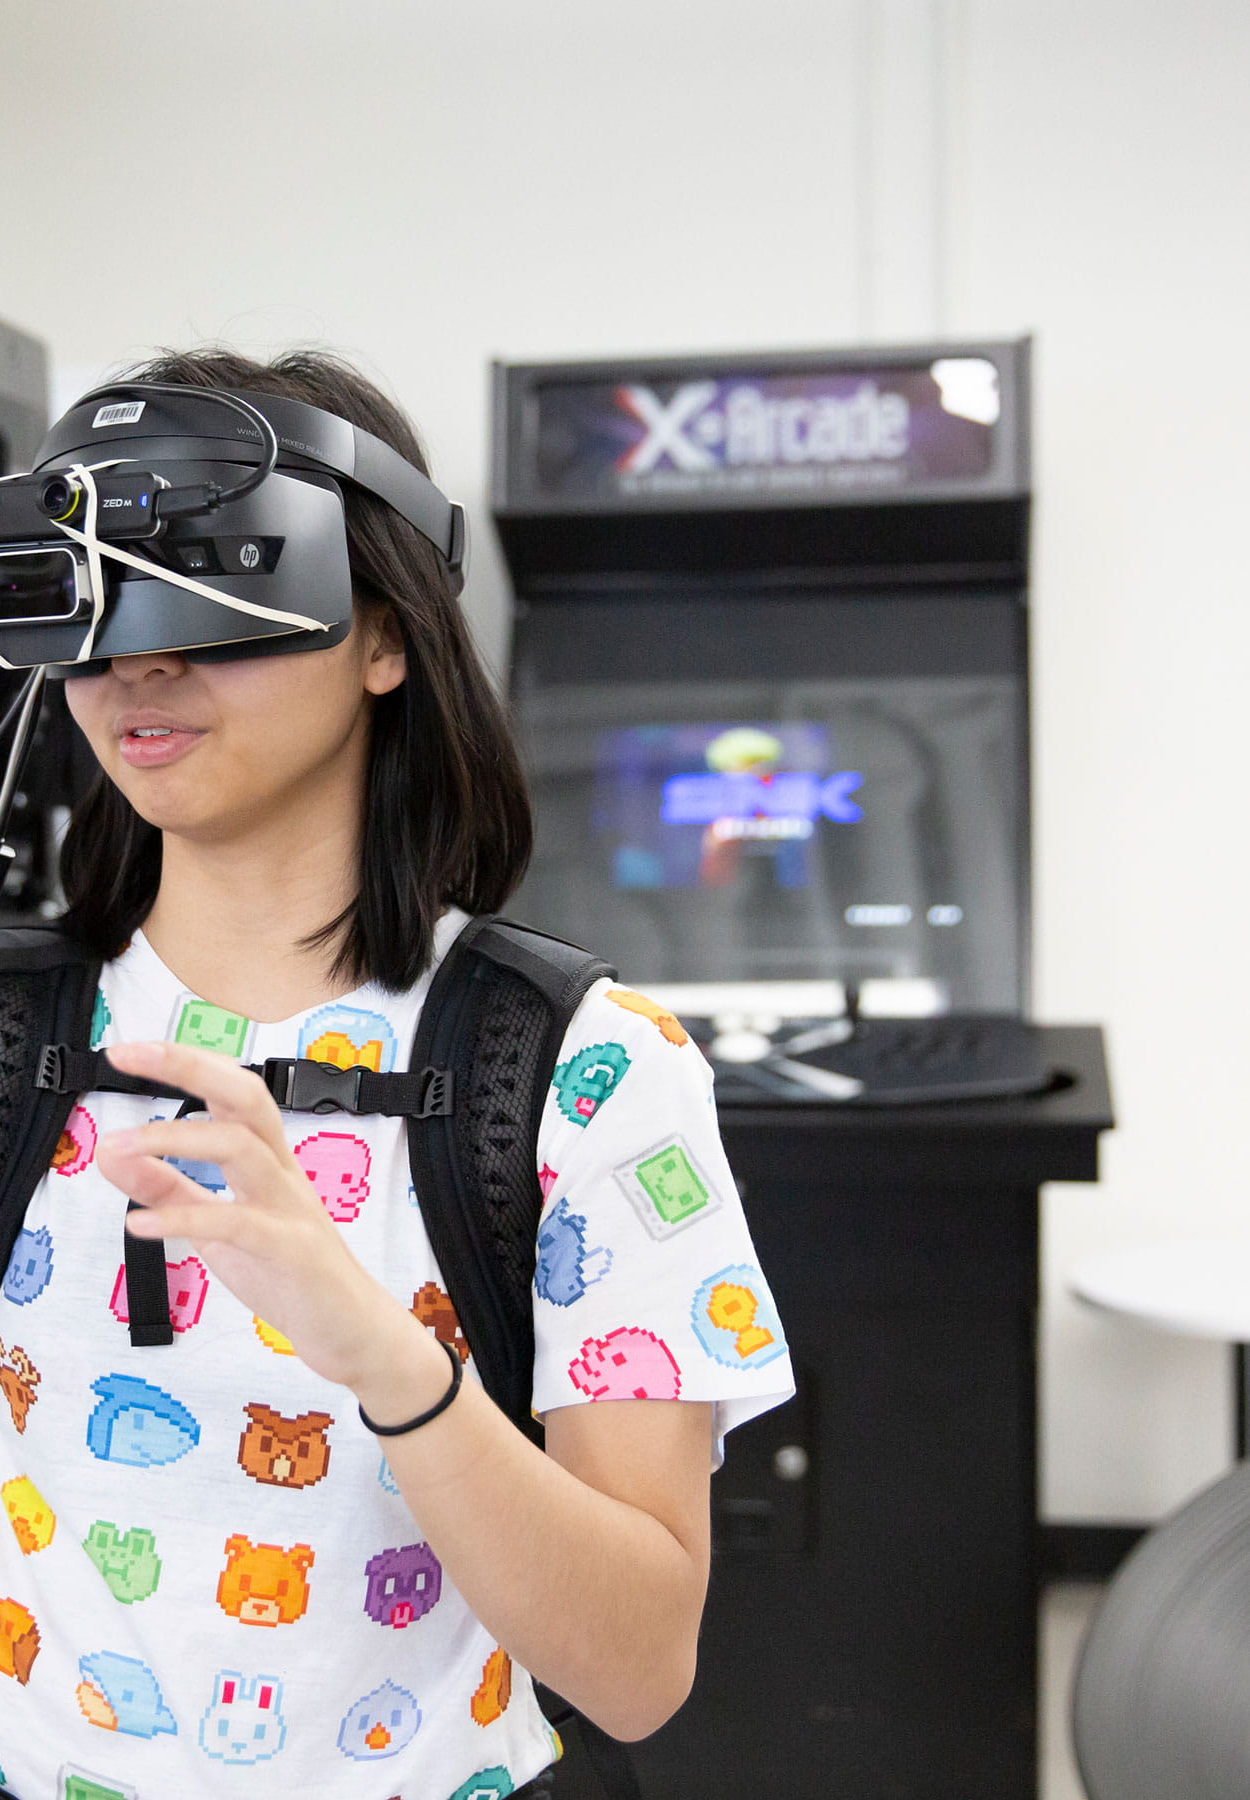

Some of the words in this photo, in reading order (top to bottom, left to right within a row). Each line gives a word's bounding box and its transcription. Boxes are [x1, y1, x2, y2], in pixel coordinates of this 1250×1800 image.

[281, 437, 306, 450] MIXED
[103, 498, 123, 508] ZED
[123, 499, 132, 507] M
[242, 543, 258, 568] hp
